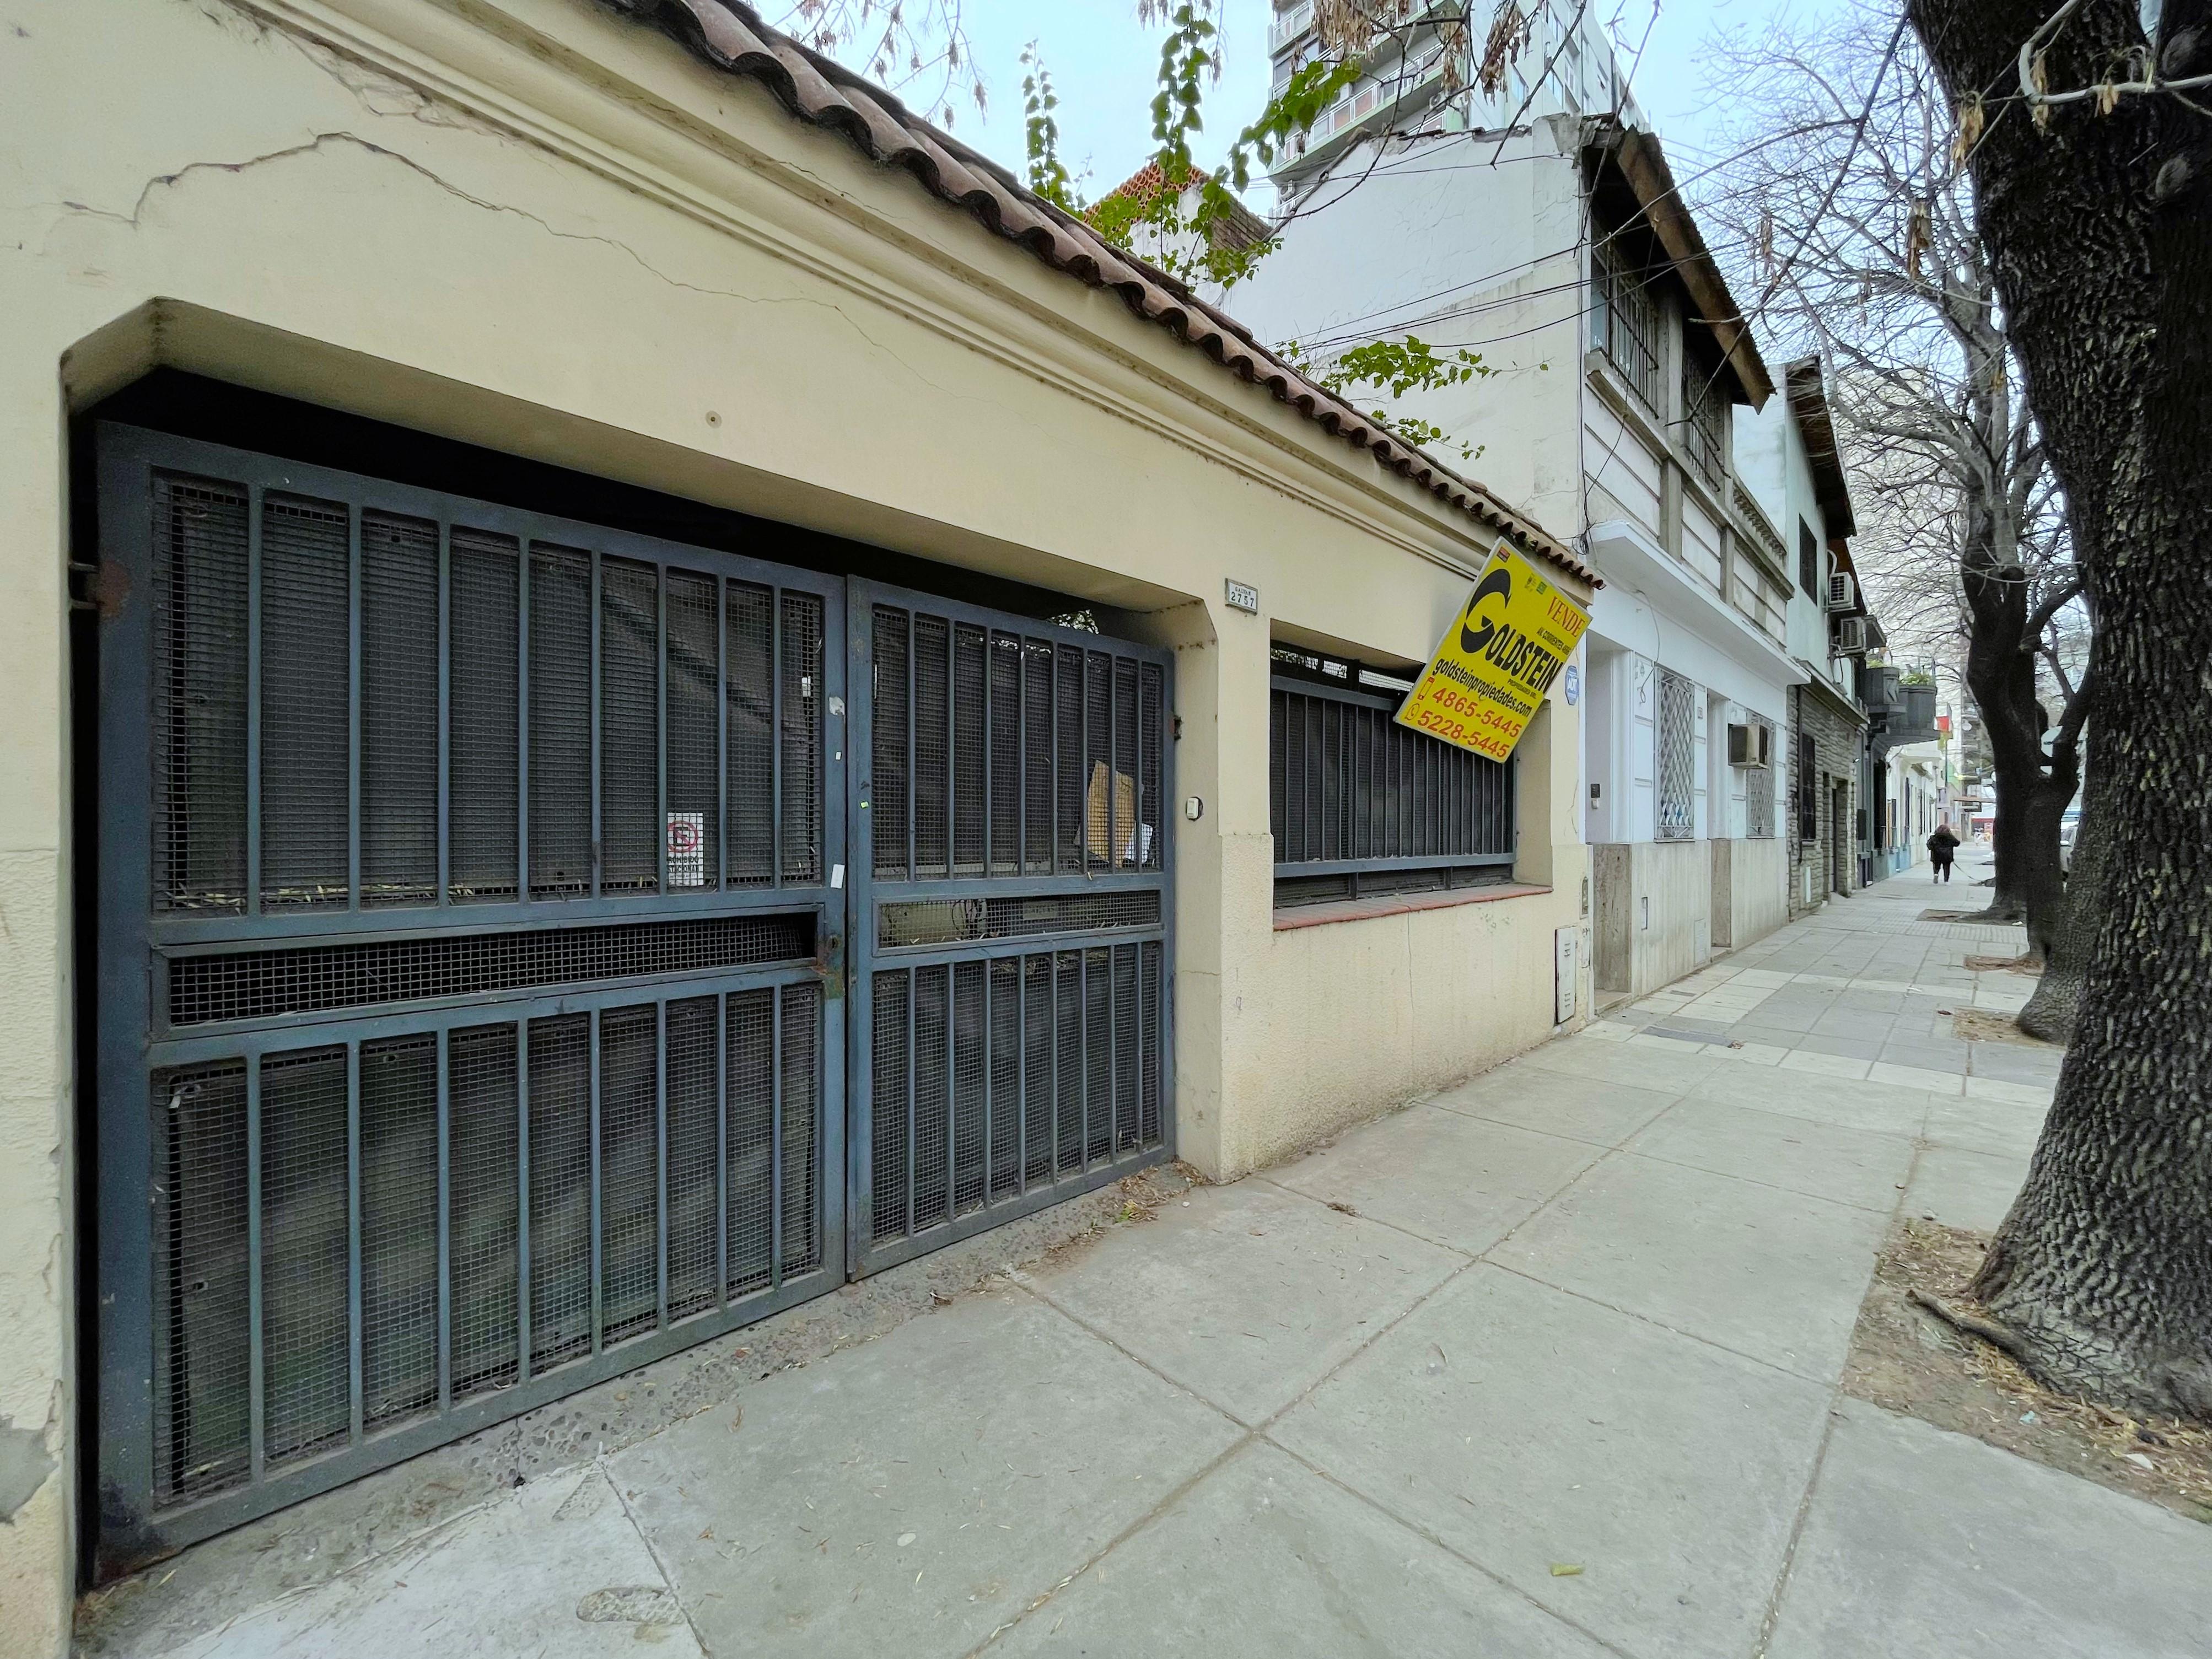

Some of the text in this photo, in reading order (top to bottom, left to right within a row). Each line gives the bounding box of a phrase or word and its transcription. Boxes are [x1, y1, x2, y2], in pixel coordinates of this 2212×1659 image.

[1231, 591, 1255, 607] 2757
[1546, 595, 1586, 638] VENDE
[1460, 568, 1563, 694] GOLDSTEIN
[1433, 658, 1533, 716] goldsteinpropiedades.com
[1418, 710, 1510, 758] 5228-5445
[1432, 687, 1522, 737] 4865-5445
